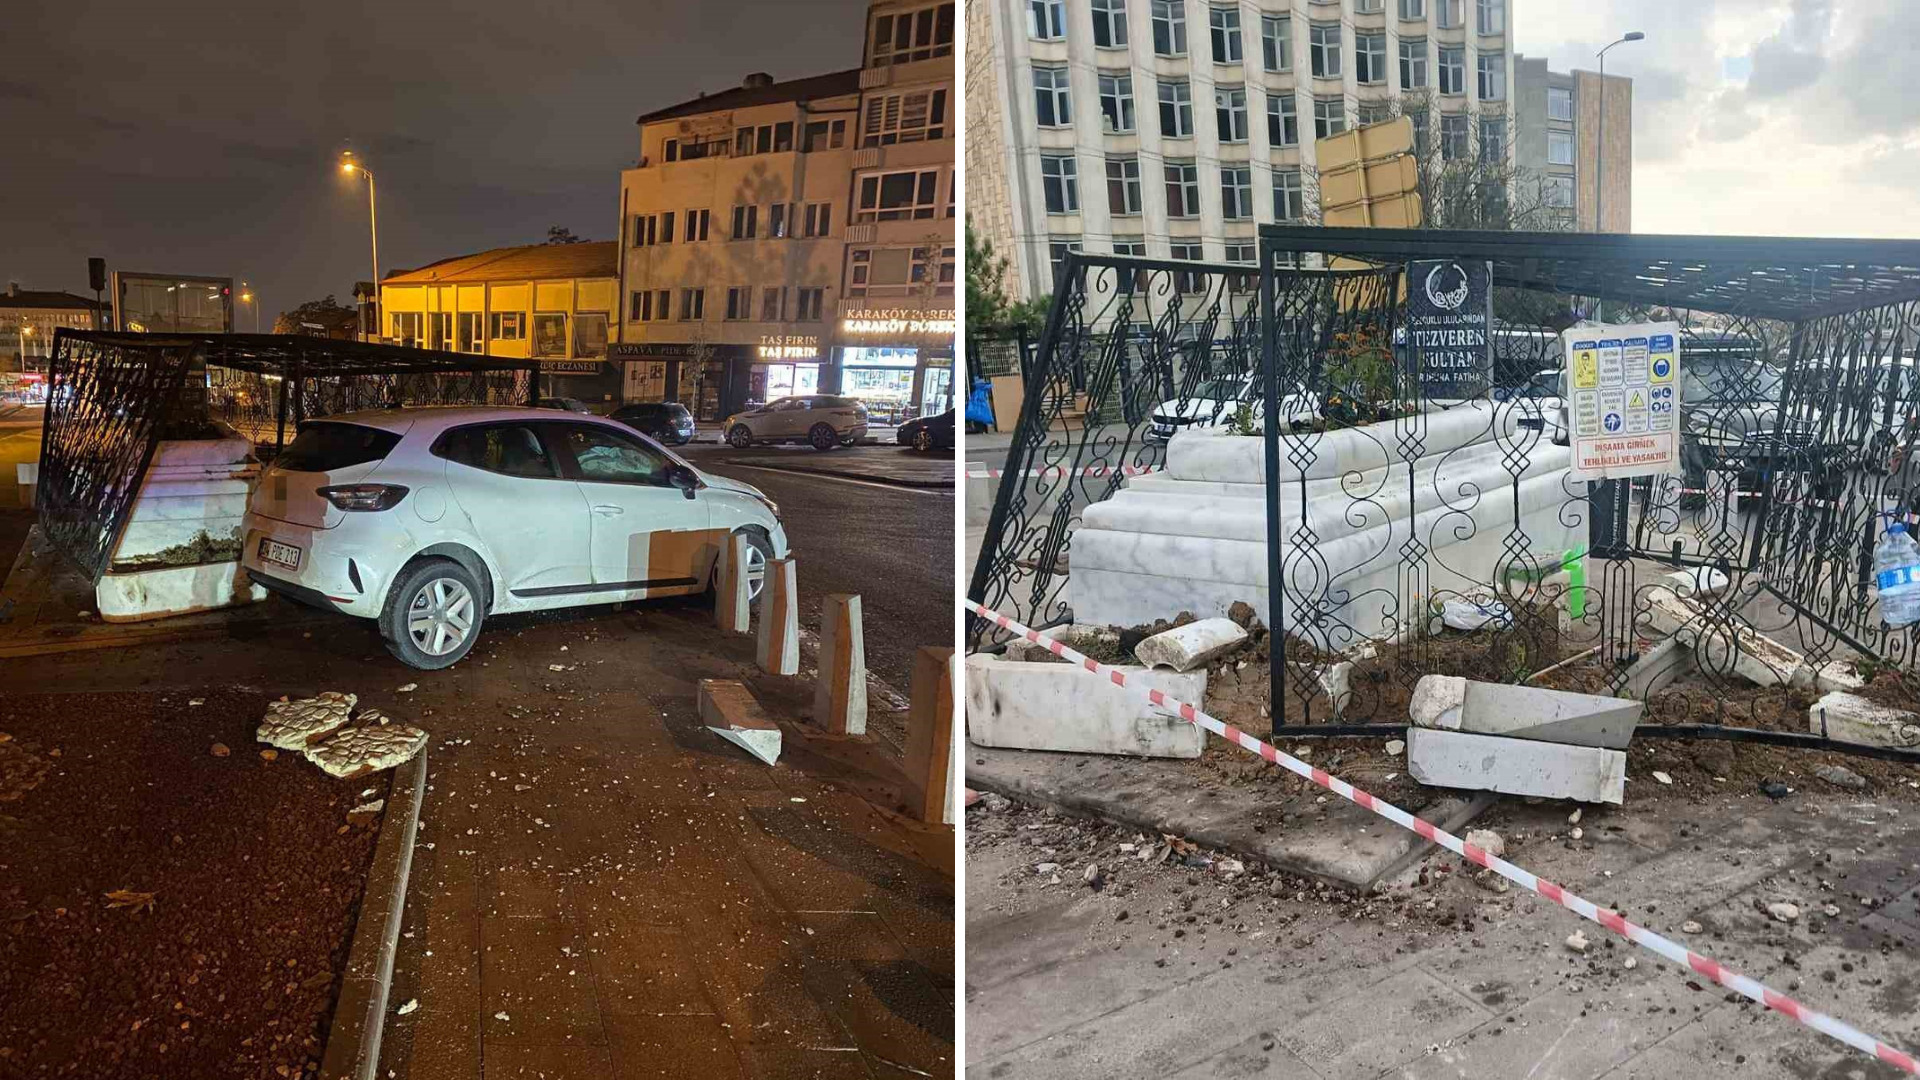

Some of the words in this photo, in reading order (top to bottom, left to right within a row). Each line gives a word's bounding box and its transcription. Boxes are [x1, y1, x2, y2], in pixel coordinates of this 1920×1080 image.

[847, 308, 908, 319] KARAKÖY
[844, 319, 908, 333] KARAKÖY
[785, 335, 818, 345] FIRIN
[1412, 329, 1485, 346] TEZVEREN
[617, 346, 653, 355] ASPAVA
[784, 346, 818, 358] FIRIN
[1621, 455, 1631, 463] VE
